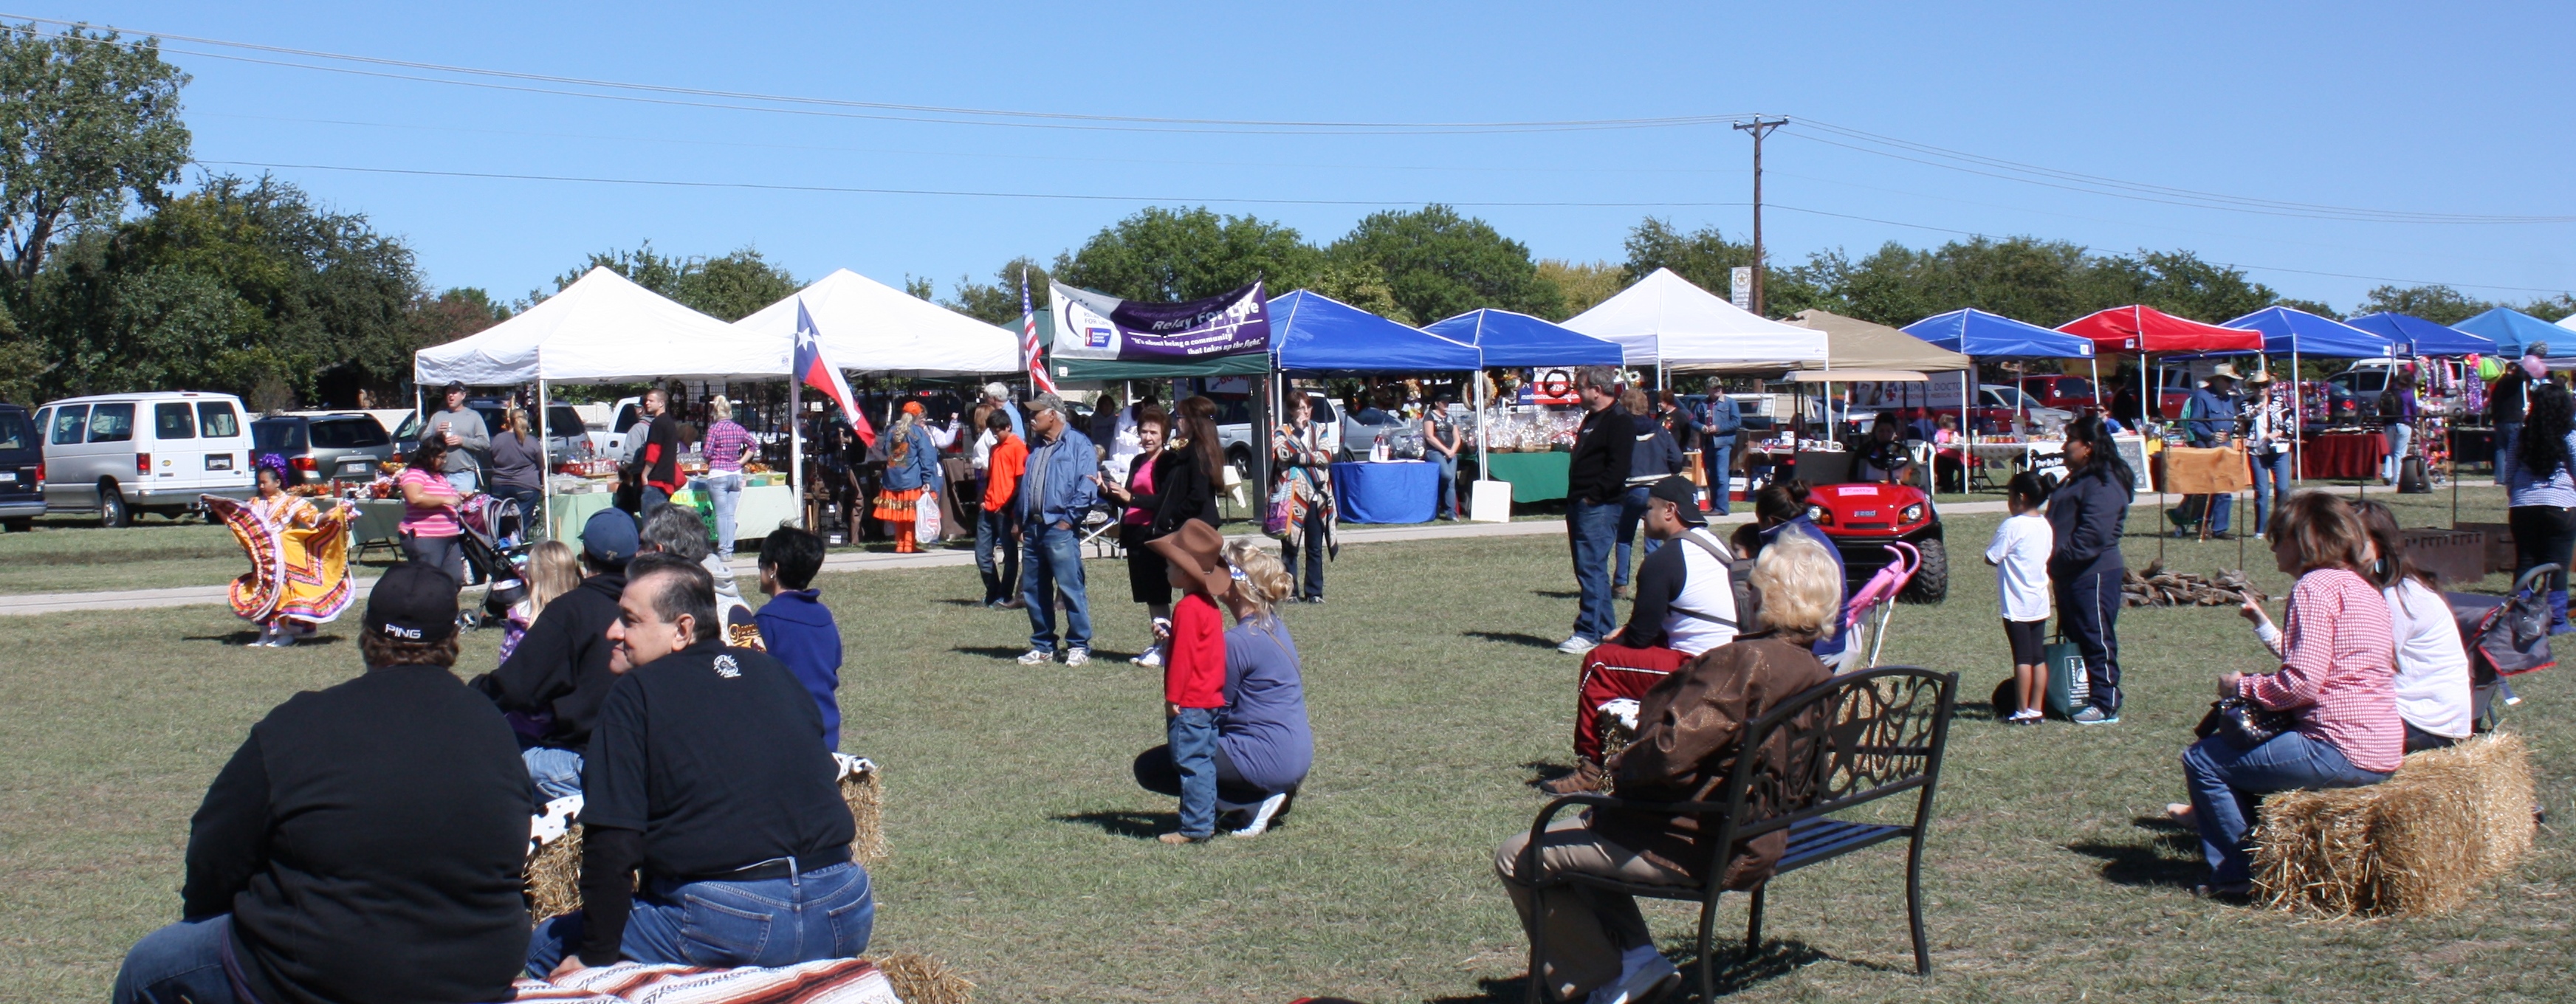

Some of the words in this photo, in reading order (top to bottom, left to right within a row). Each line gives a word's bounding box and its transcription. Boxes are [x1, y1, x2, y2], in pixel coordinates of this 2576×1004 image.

[1152, 317, 1193, 330] Relay
[1197, 309, 1223, 323] For
[1164, 340, 1184, 348] being
[1190, 333, 1233, 345] community
[1203, 345, 1223, 353] takes
[1898, 382, 1931, 392] ANIML
[385, 623, 422, 639] PING
